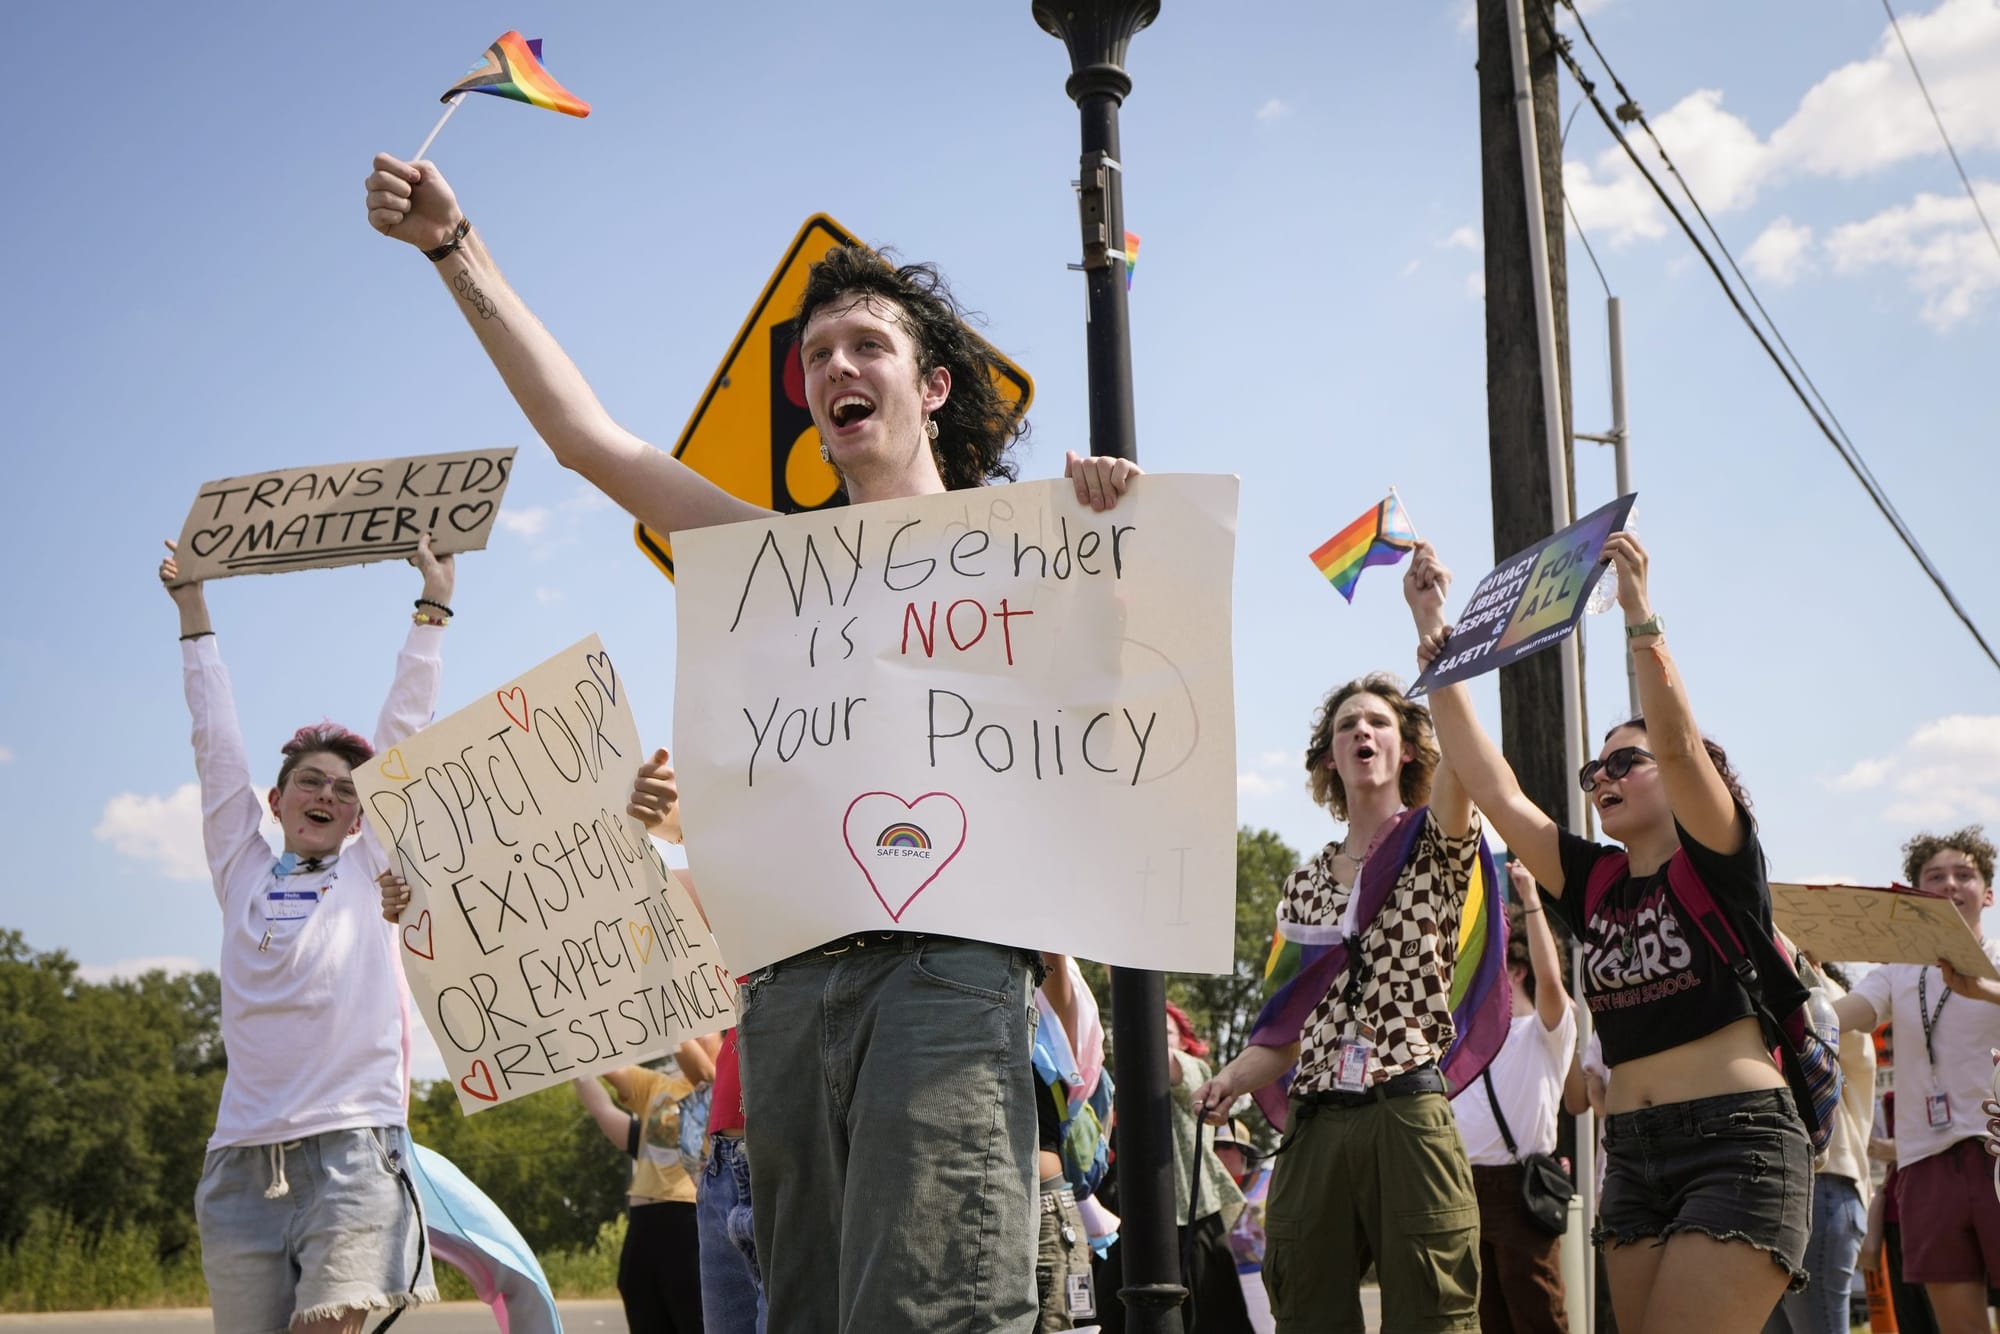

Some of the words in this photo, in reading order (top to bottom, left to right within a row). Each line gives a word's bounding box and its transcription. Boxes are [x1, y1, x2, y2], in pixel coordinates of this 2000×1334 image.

[200, 467, 384, 520] TRANS
[396, 457, 513, 500] KIDS
[229, 506, 440, 558] MATTER!
[883, 517, 1137, 592] Gender
[1535, 540, 1591, 589] FOR
[1464, 574, 1529, 618] LIBERTY
[1518, 576, 1570, 623] ALL
[809, 616, 859, 668] is
[1492, 618, 1506, 635] &
[1434, 638, 1498, 676] SAFETY
[743, 696, 867, 787] your
[927, 688, 1157, 786] Policy
[370, 725, 542, 887] RESPECT
[533, 679, 622, 783] OUR
[877, 849, 899, 857] SAFE
[902, 849, 931, 859] SPACE
[437, 973, 528, 1053] OR
[518, 918, 635, 1019] EXPECT
[634, 888, 701, 961] THE
[1610, 986, 1641, 1009] HIGH
[1641, 969, 1702, 1003] SCHOOL
[494, 962, 731, 1090] RESISTANCE
